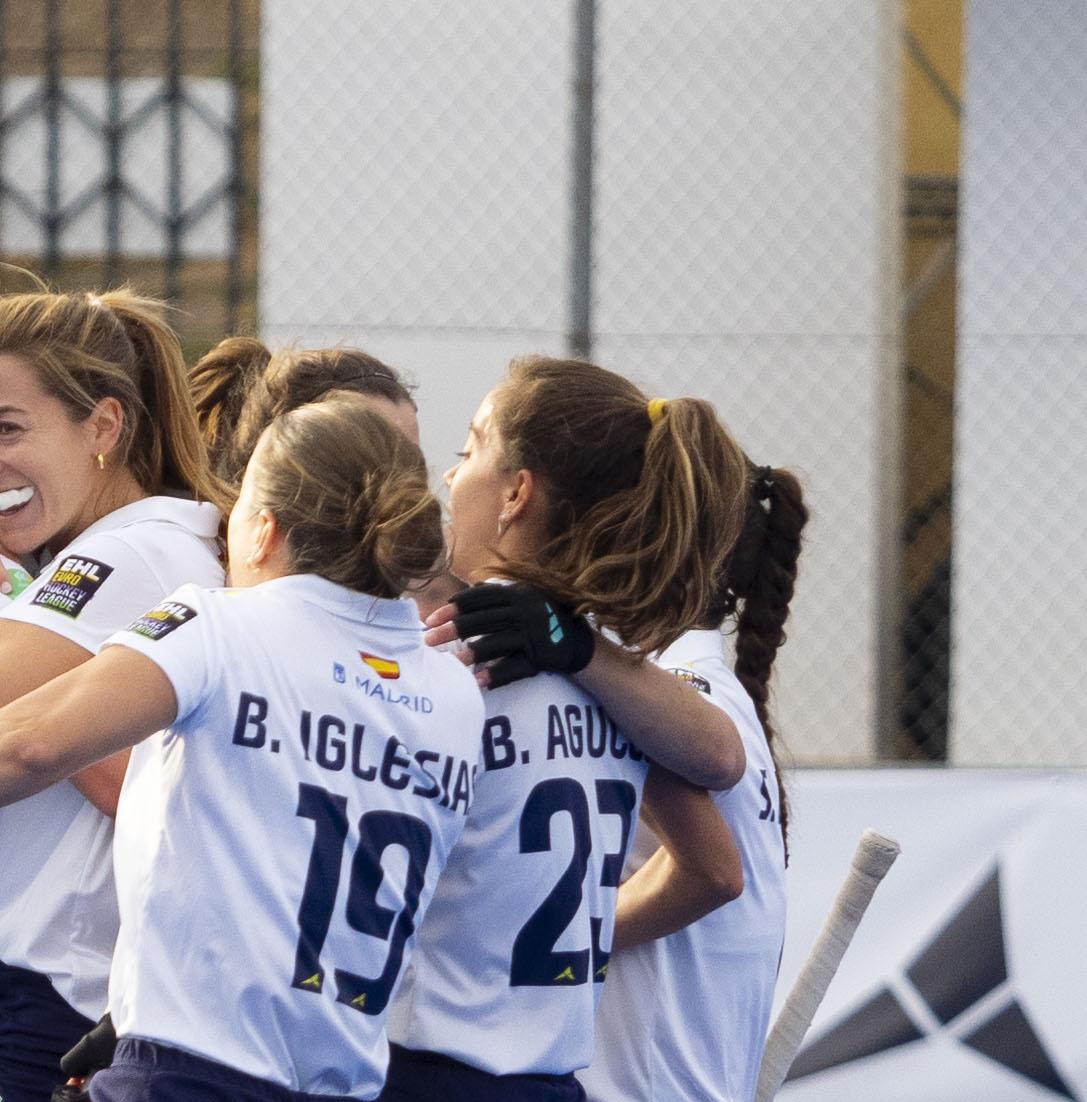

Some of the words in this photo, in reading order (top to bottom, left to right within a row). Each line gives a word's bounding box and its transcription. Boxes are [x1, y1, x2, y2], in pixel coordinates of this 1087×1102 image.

[52, 571, 82, 586] EURO
[59, 558, 100, 582] EHL
[35, 592, 78, 611] LEAGUE
[43, 583, 87, 601] HOCKEY
[232, 691, 280, 754] B.
[300, 710, 477, 817] IGLESIA
[482, 714, 530, 771] B.
[291, 781, 433, 1016] 19
[509, 776, 637, 988] 23
